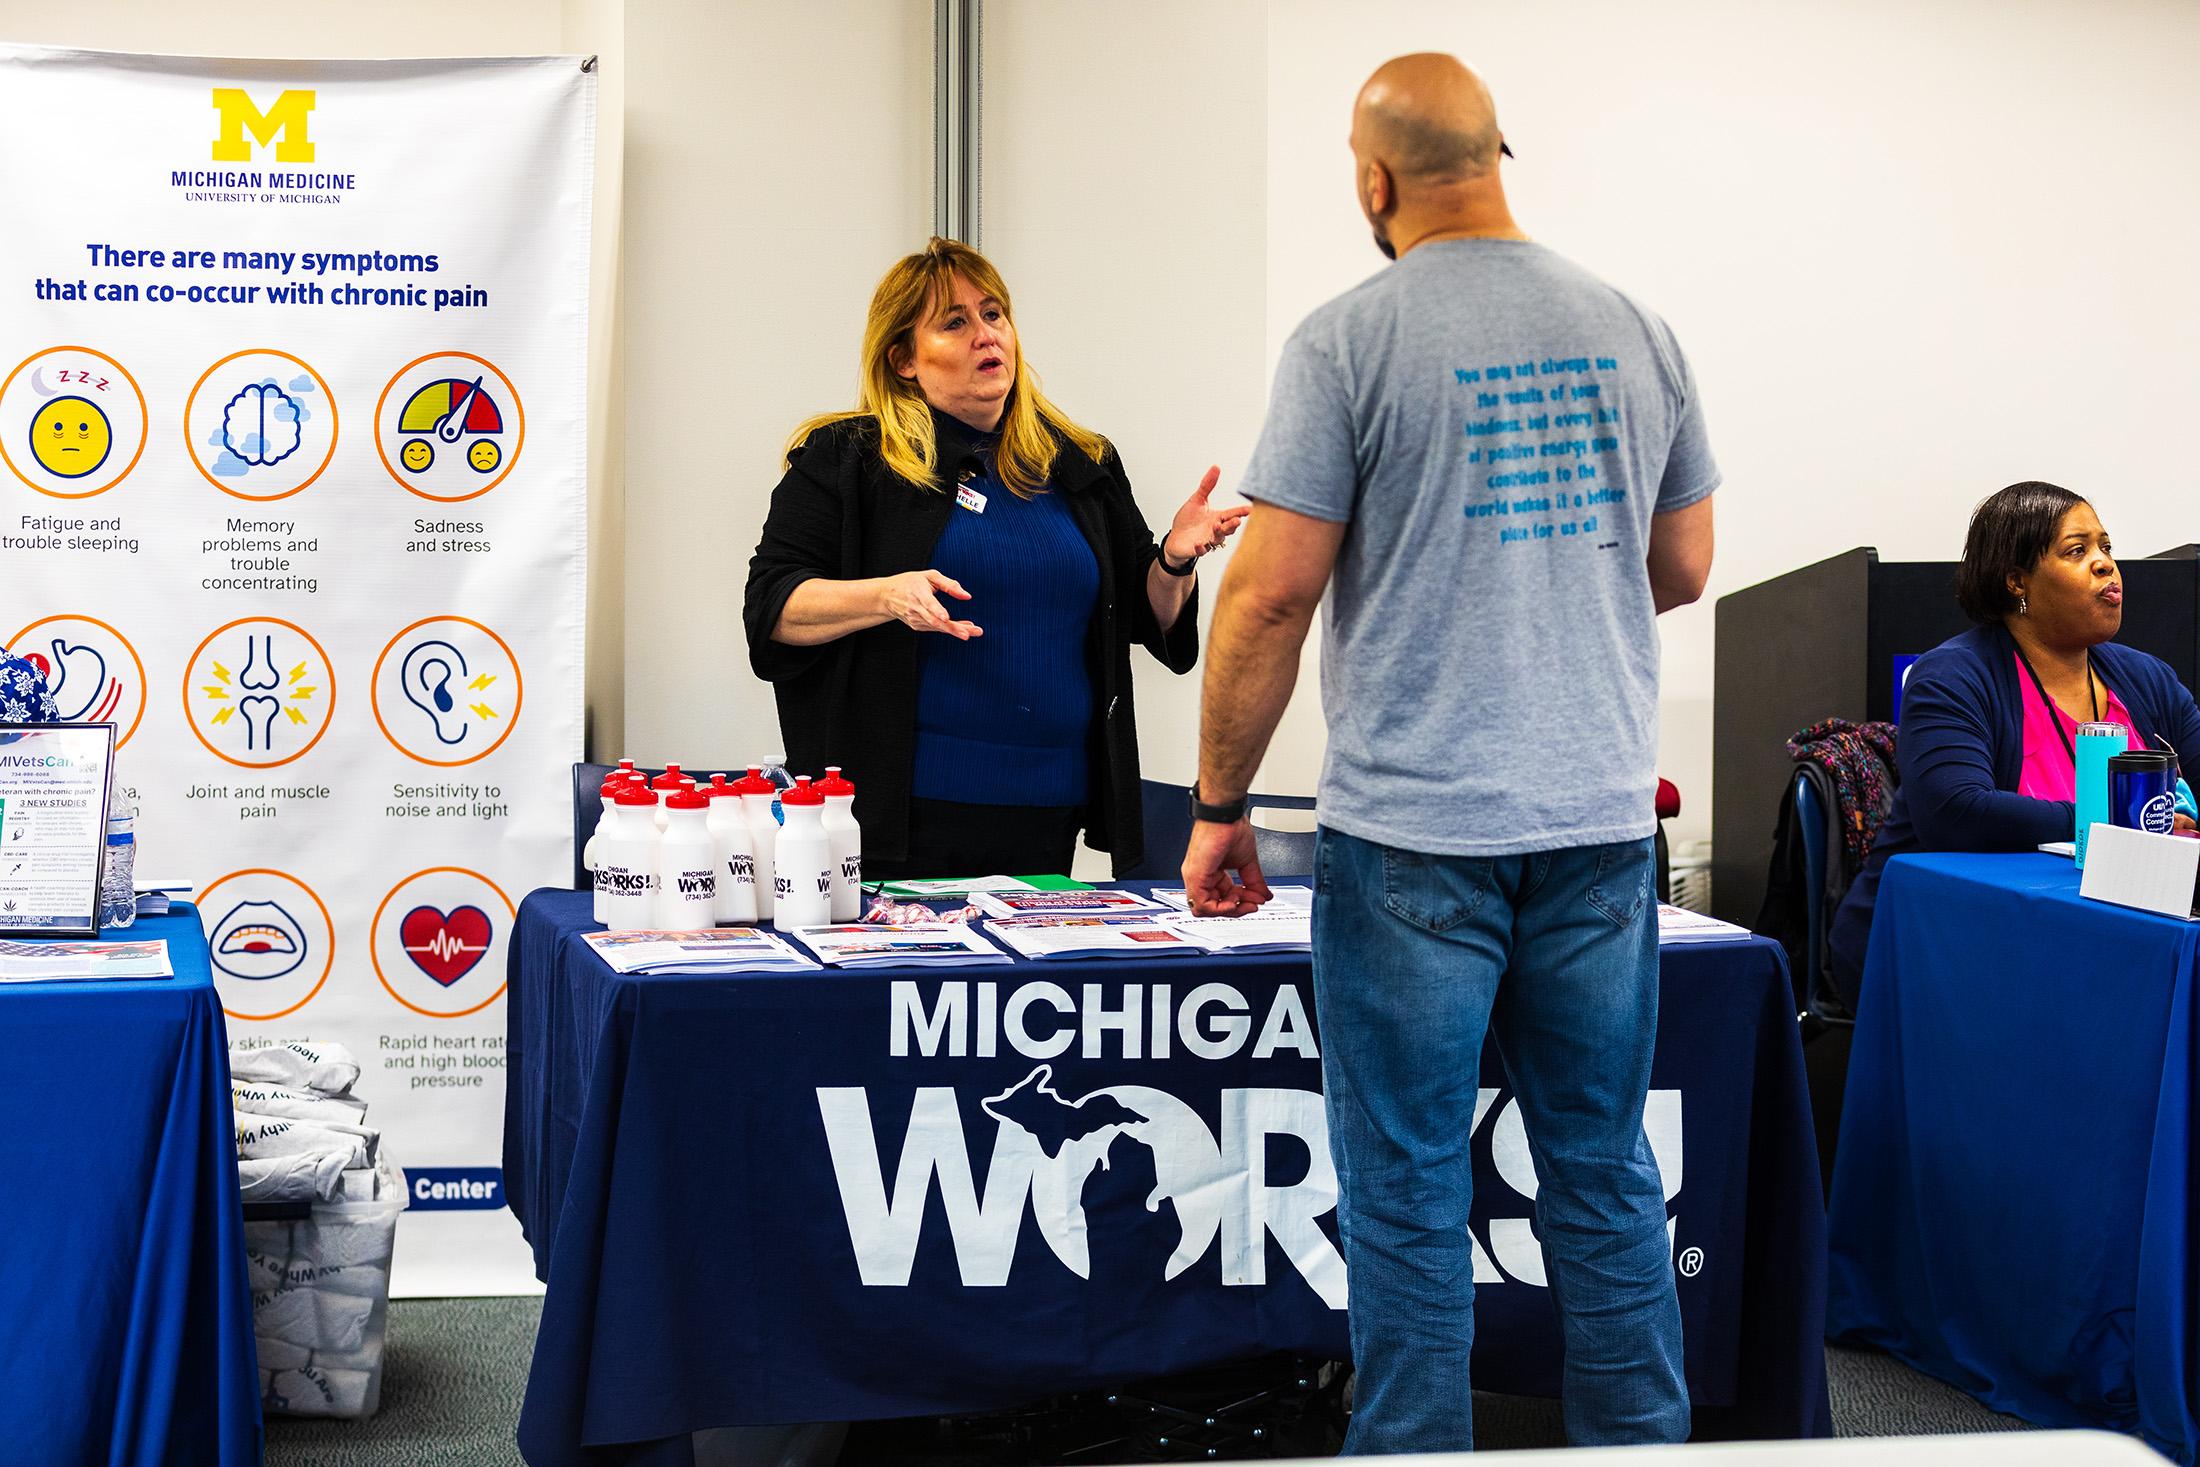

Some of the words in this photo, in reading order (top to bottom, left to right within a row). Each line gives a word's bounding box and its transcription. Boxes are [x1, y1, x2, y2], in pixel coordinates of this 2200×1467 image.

[212, 88, 316, 163] M
[171, 171, 262, 188] MICHIGAN
[269, 173, 355, 190] MEDICINE
[185, 192, 257, 203] UNIVERSITY
[260, 193, 276, 203] OF
[279, 194, 341, 204] MICHIGAN
[87, 244, 165, 267] There
[172, 250, 216, 268] are
[223, 251, 295, 275] many
[301, 250, 439, 276] symptoms
[35, 278, 87, 300] that
[94, 283, 139, 302] can
[146, 283, 260, 304] co-occur
[266, 282, 324, 305] with
[330, 283, 428, 306] chronic
[434, 285, 488, 311] pain
[1556, 466, 1572, 482] to
[1573, 494, 1582, 508] a
[21, 515, 84, 531] Fatigue
[90, 517, 121, 531] and
[227, 518, 295, 533] Memory
[414, 519, 484, 533] Sadness
[1533, 522, 1554, 539] for
[1560, 521, 1577, 536] us
[2, 535, 62, 549] trouble
[68, 535, 139, 553] sleeping
[202, 538, 281, 552] problems
[288, 538, 318, 551] and
[406, 538, 436, 552] and
[442, 540, 491, 552] stress
[231, 557, 290, 570] trouble
[202, 575, 318, 593] concentrating
[186, 784, 228, 799] Joint
[234, 785, 265, 799] and
[271, 785, 331, 799] muscle
[393, 784, 479, 801] Sensitivity
[485, 785, 501, 798] to
[240, 803, 277, 820] pain
[386, 802, 431, 817] noise
[436, 803, 466, 817] and
[472, 802, 509, 820] light
[889, 981, 1321, 1059] MICHIGA
[240, 1036, 273, 1051] skin
[380, 1034, 428, 1051] Rapid
[433, 1035, 476, 1049] heart
[384, 1054, 415, 1069] and
[421, 1053, 457, 1072] high
[411, 1074, 483, 1089] pressure
[415, 1177, 498, 1200] Center
